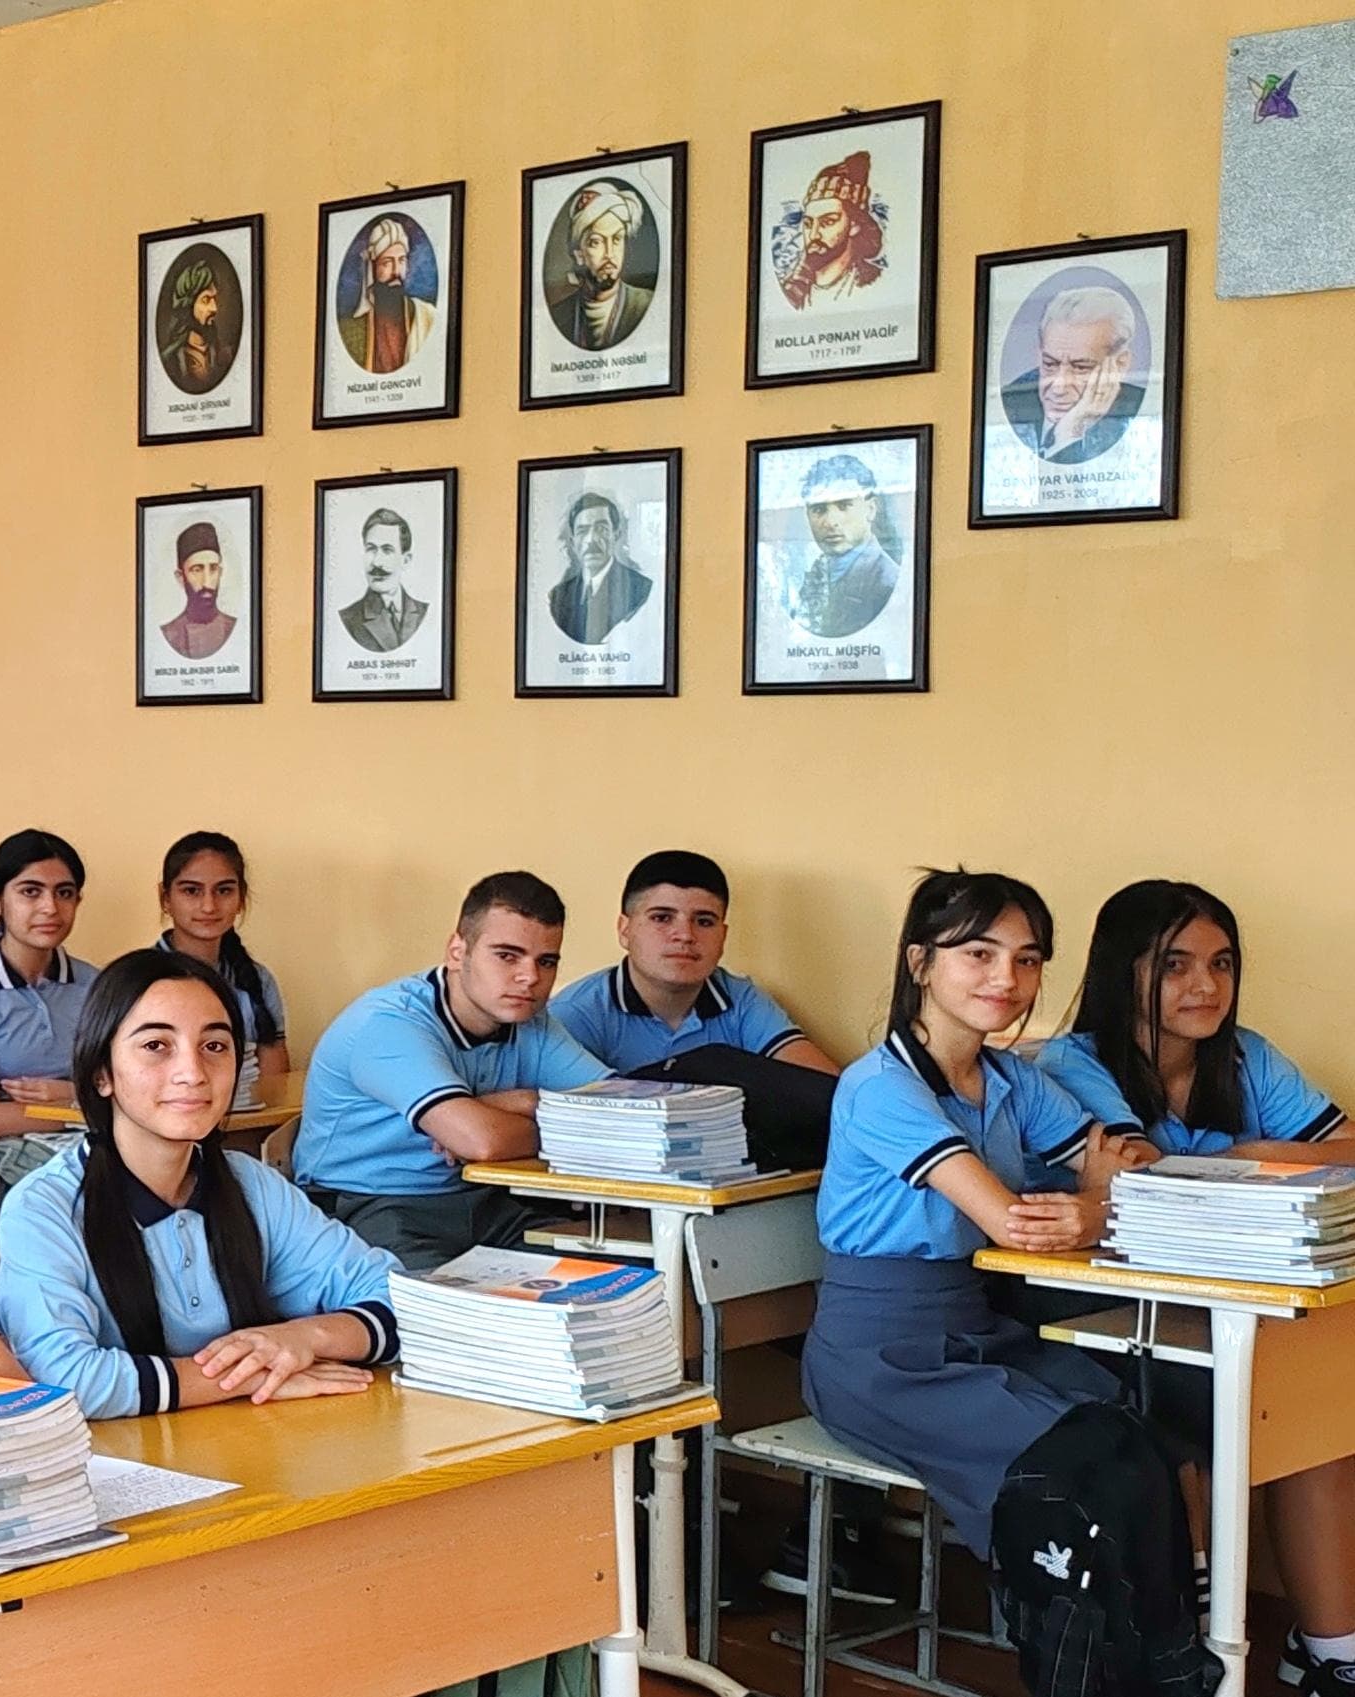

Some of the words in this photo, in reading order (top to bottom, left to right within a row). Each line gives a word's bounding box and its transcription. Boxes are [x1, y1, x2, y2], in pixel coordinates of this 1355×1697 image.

[774, 335, 815, 348] MOLLA
[818, 329, 860, 343] PƏNAH
[862, 323, 899, 339] VAQİF
[810, 348, 831, 359] 1717
[840, 345, 861, 356] 1797
[1064, 471, 1138, 484] VAHABZAD
[1041, 489, 1065, 500] 1925
[835, 643, 881, 658] MÜŞFİQ
[347, 660, 378, 670] ABBAS
[837, 660, 859, 671] 1938
